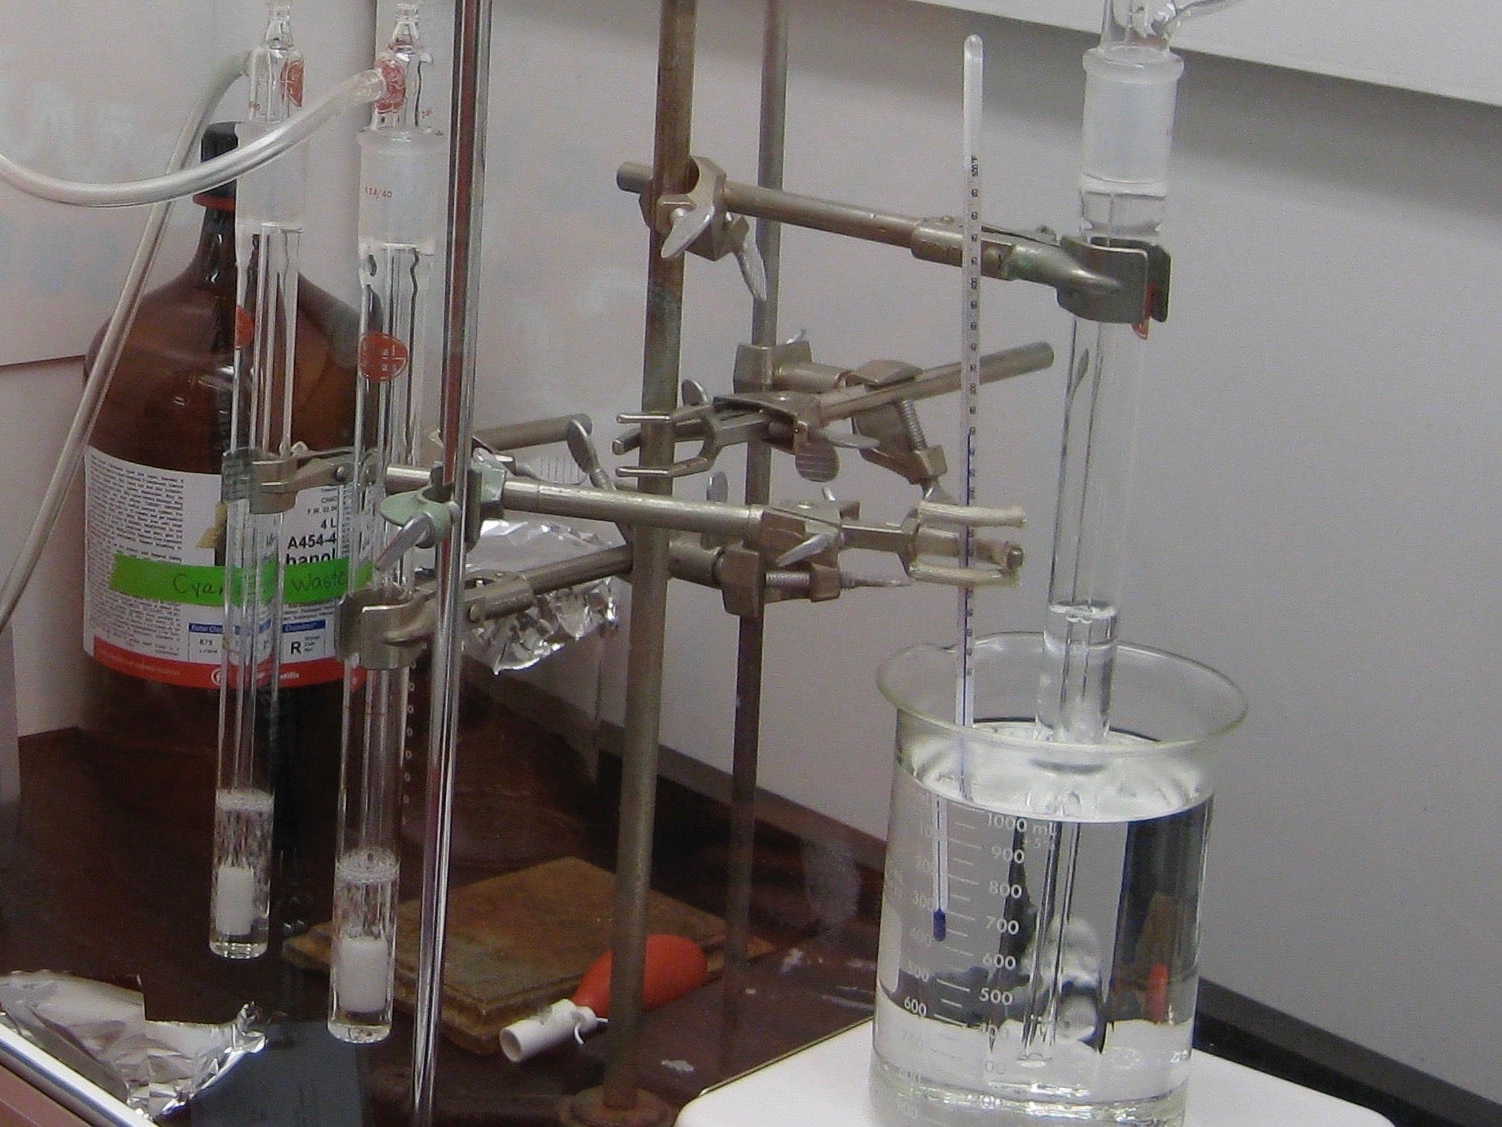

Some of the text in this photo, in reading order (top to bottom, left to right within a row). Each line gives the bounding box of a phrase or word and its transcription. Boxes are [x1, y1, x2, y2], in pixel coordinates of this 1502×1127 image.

[320, 518, 327, 530] 4
[287, 531, 337, 550] A454-4
[290, 640, 302, 655] R
[986, 811, 1028, 833] 1000
[990, 844, 1026, 864] 900
[988, 879, 1023, 899] 800
[985, 915, 1020, 935] 700
[981, 953, 1017, 971] 600
[903, 995, 928, 1017] 600
[978, 987, 1014, 1006] 500
